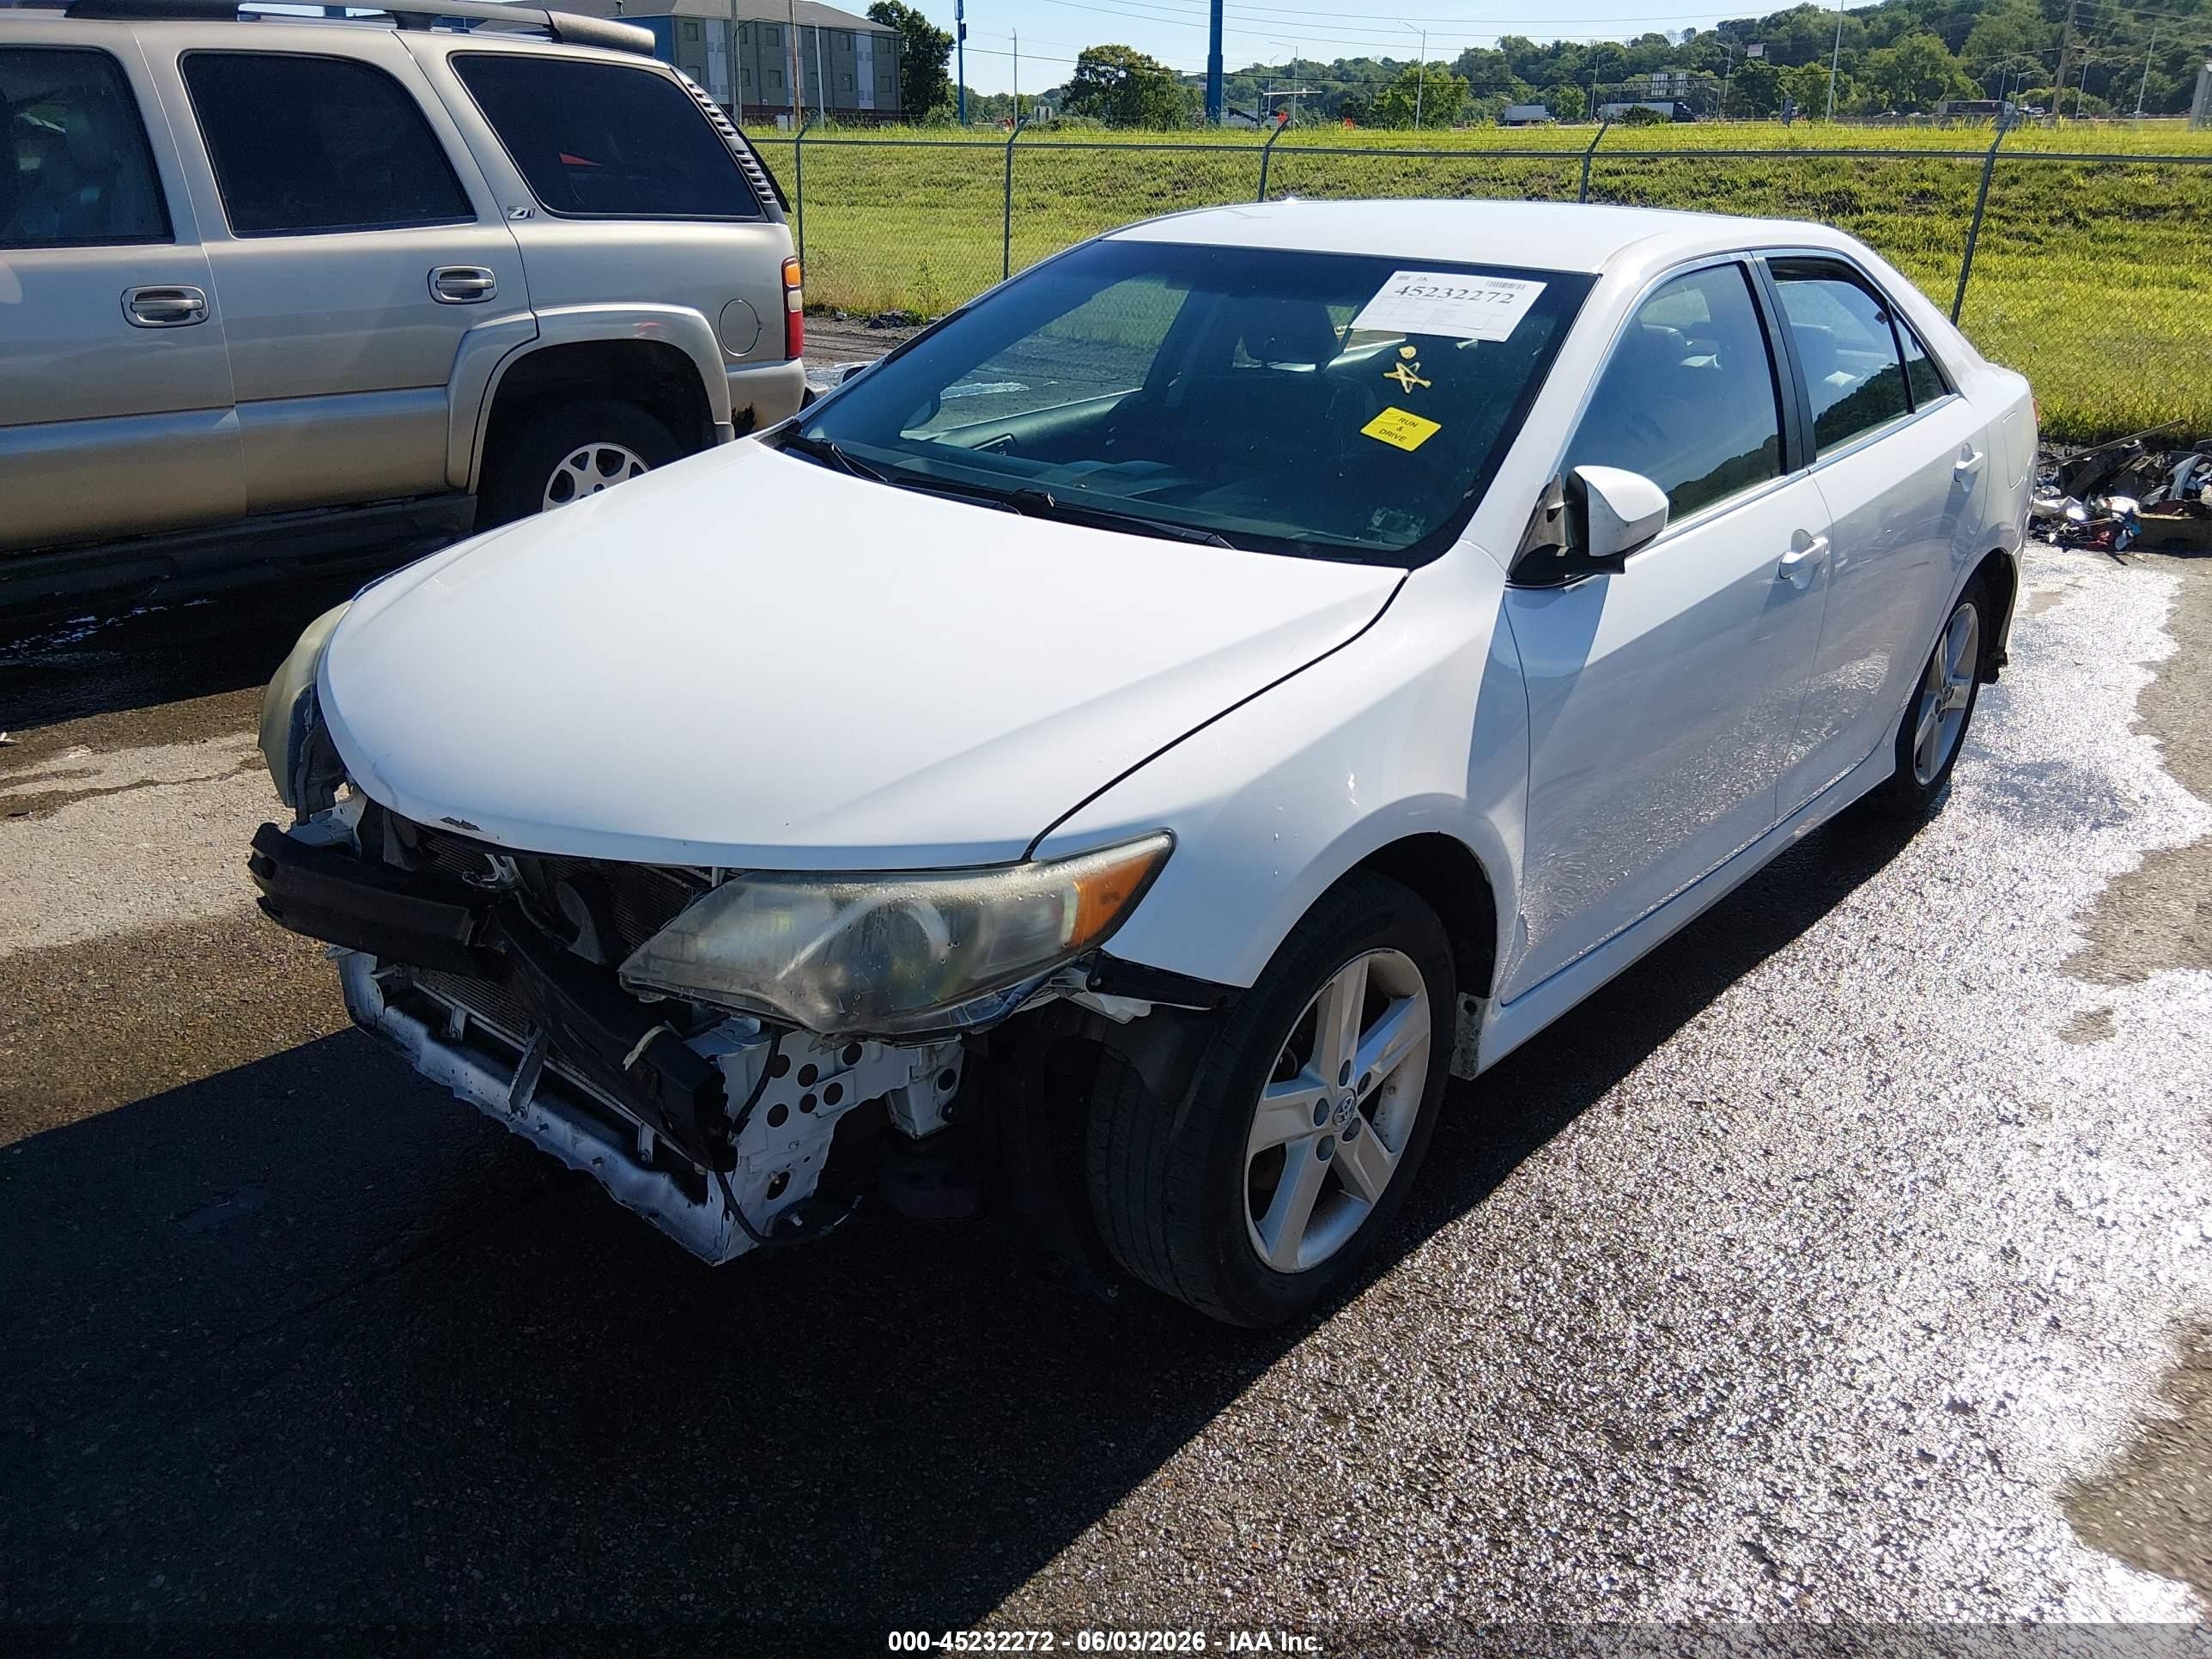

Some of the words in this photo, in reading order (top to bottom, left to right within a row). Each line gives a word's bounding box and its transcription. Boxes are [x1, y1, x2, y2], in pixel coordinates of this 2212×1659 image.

[1395, 284, 1515, 304] 45232272
[1397, 417, 1419, 428] RUN
[1379, 428, 1407, 443] DRIVE
